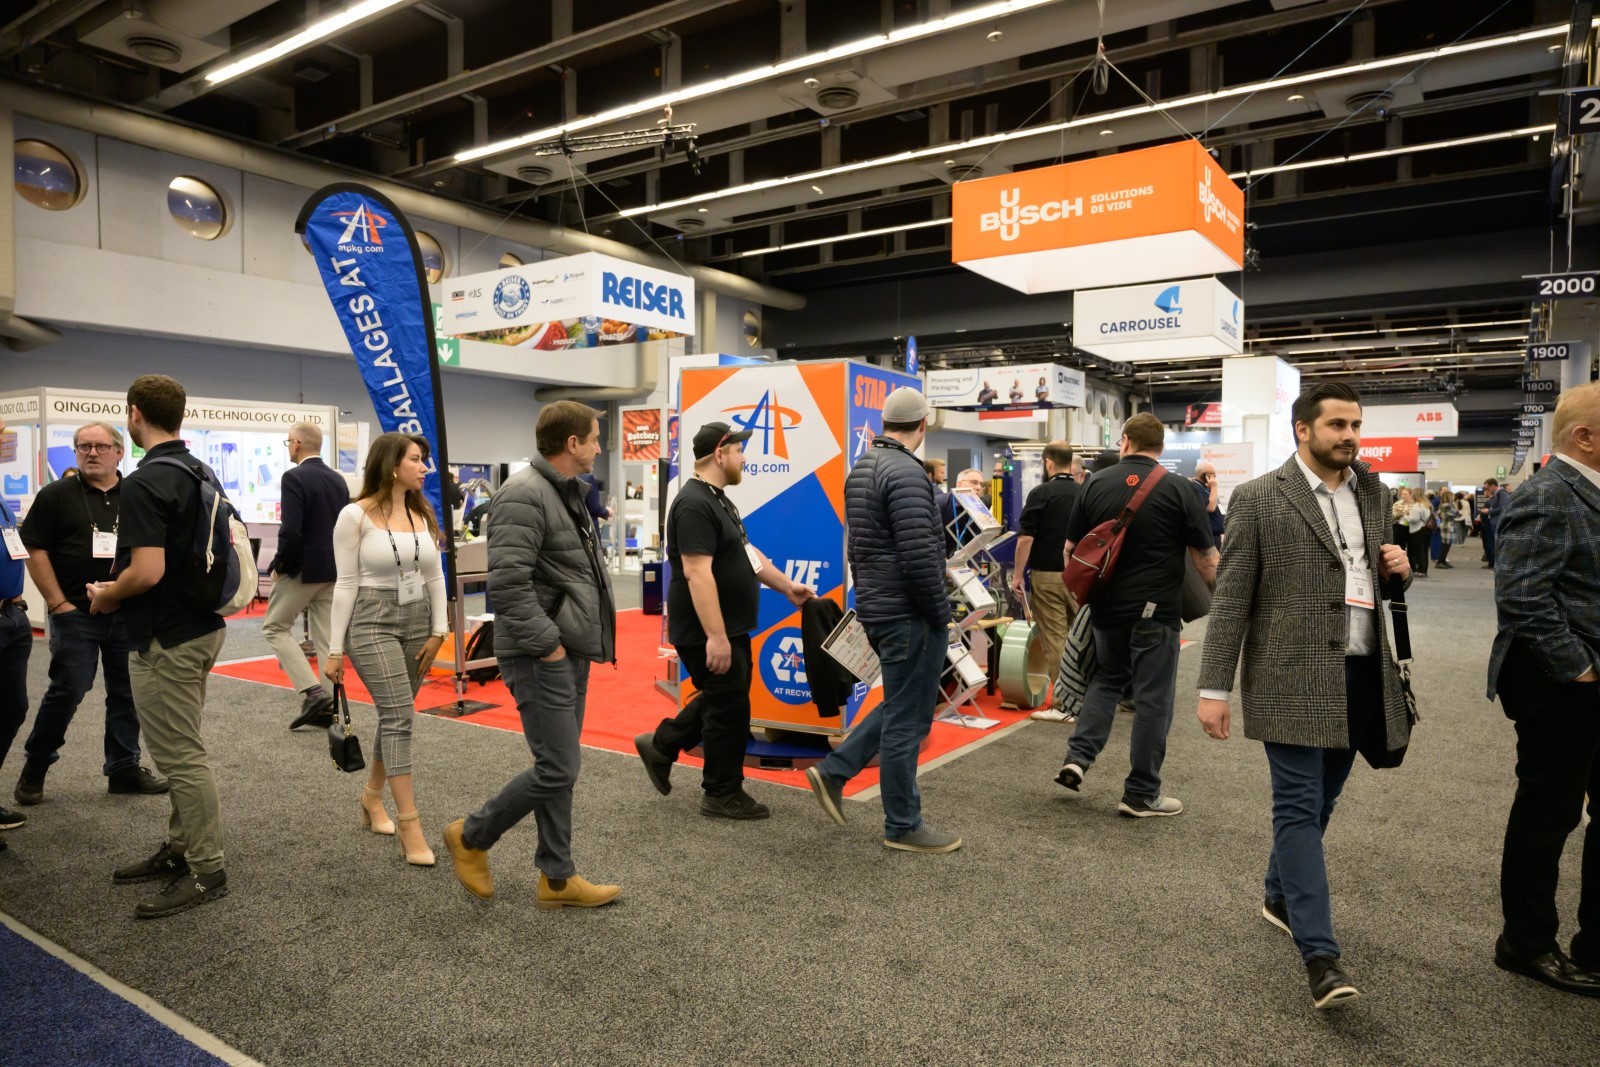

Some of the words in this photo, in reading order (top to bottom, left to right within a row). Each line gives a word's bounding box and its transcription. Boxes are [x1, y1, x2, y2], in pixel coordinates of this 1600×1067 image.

[1199, 166, 1226, 223] BUSCH
[980, 188, 1083, 241] BUSCH
[1091, 185, 1154, 203] SOLUTIONS
[1091, 205, 1105, 214] DE
[1107, 200, 1132, 212] VIDE
[331, 257, 366, 287] AT
[1540, 277, 1595, 295] 2000
[602, 271, 685, 319] REISER
[1100, 317, 1181, 334] CARROUSEL
[1532, 346, 1567, 359] 1900
[1526, 382, 1552, 391] 1800
[54, 400, 121, 415] QINGDAO
[202, 409, 279, 422] TECHNOLOGY
[1416, 412, 1443, 422] ABB
[627, 431, 659, 441] Butcher's
[1358, 446, 1392, 457] KHOFF
[785, 688, 812, 698] RECYK
